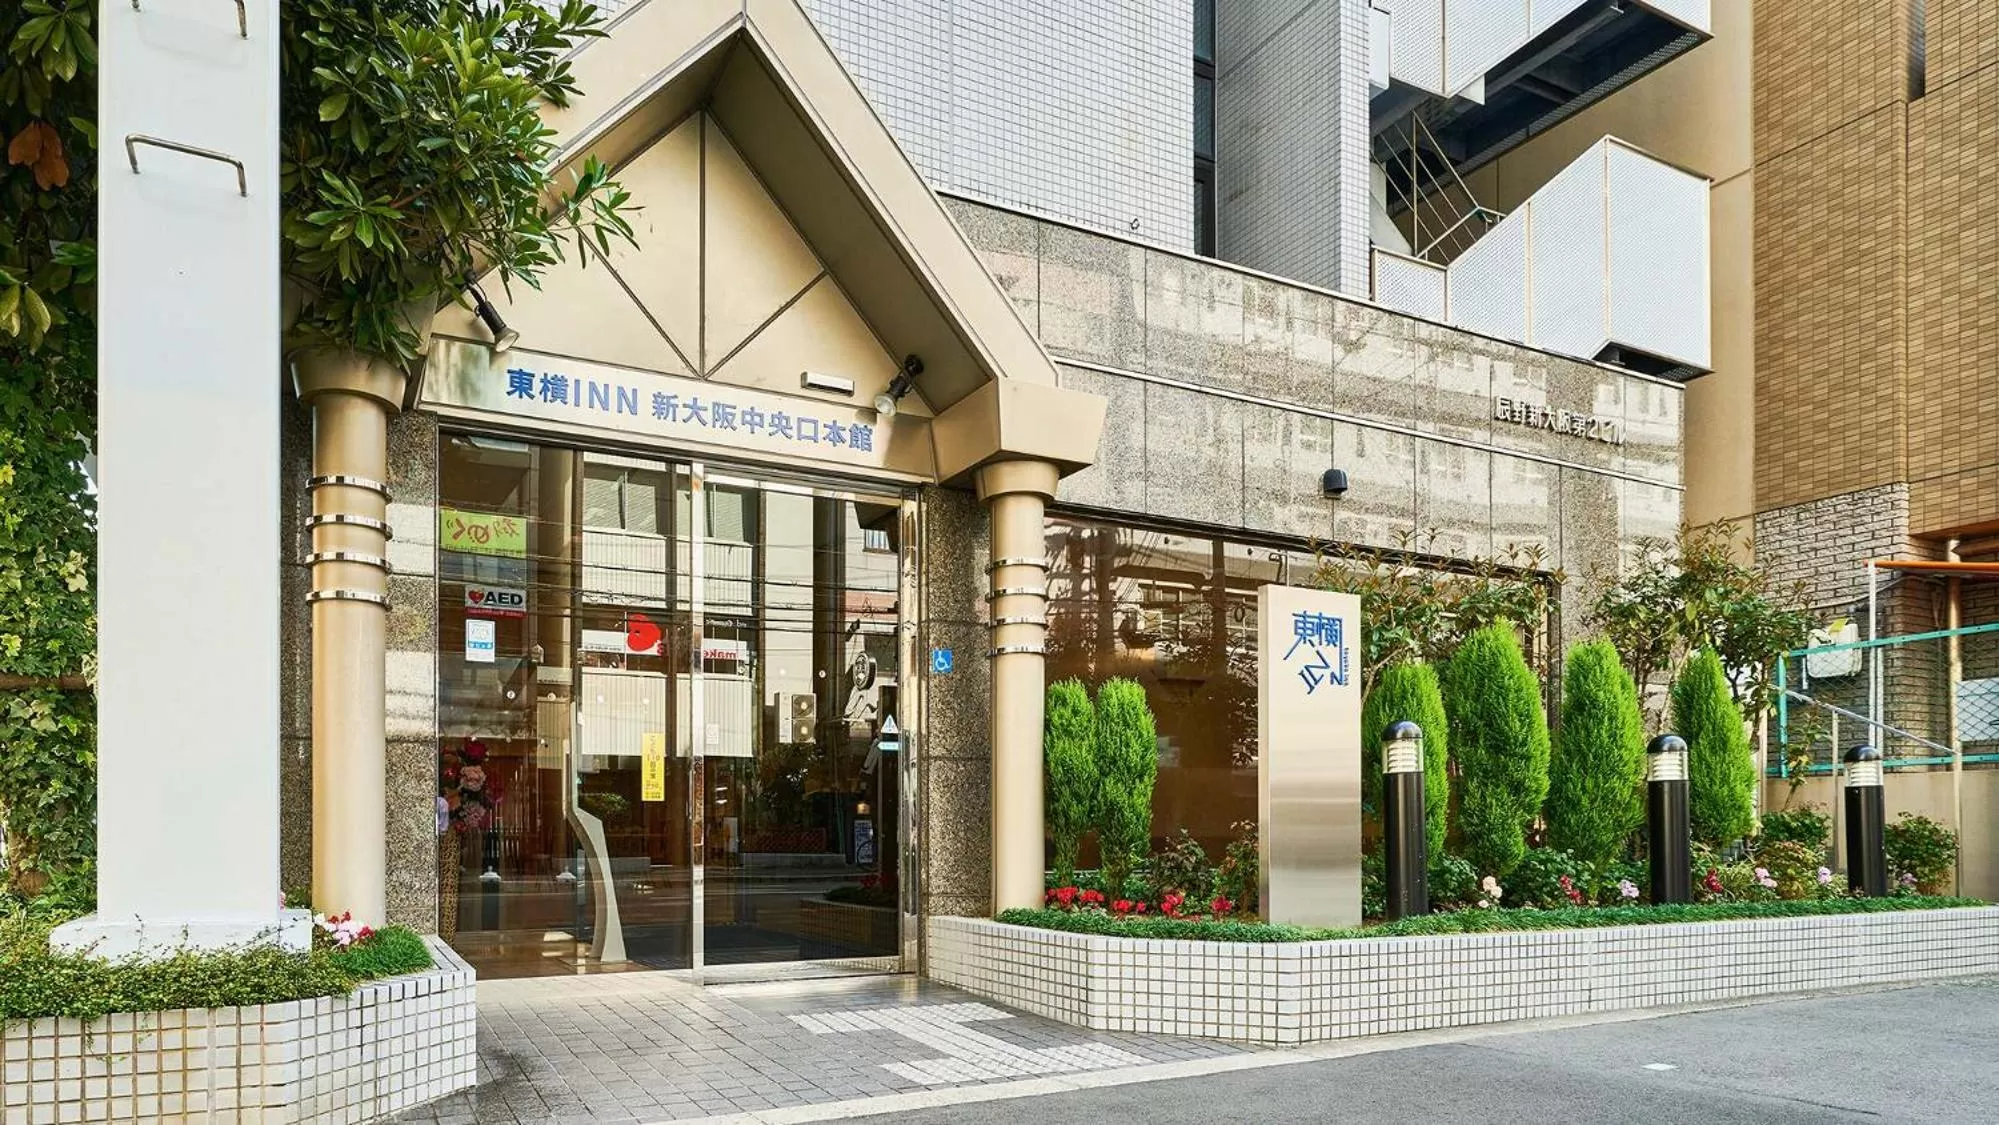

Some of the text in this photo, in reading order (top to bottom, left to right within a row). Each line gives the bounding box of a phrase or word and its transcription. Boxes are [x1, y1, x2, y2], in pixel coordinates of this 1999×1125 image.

[506, 368, 874, 453] 東横INN 新大阪中央口本館
[483, 591, 523, 606] AED
